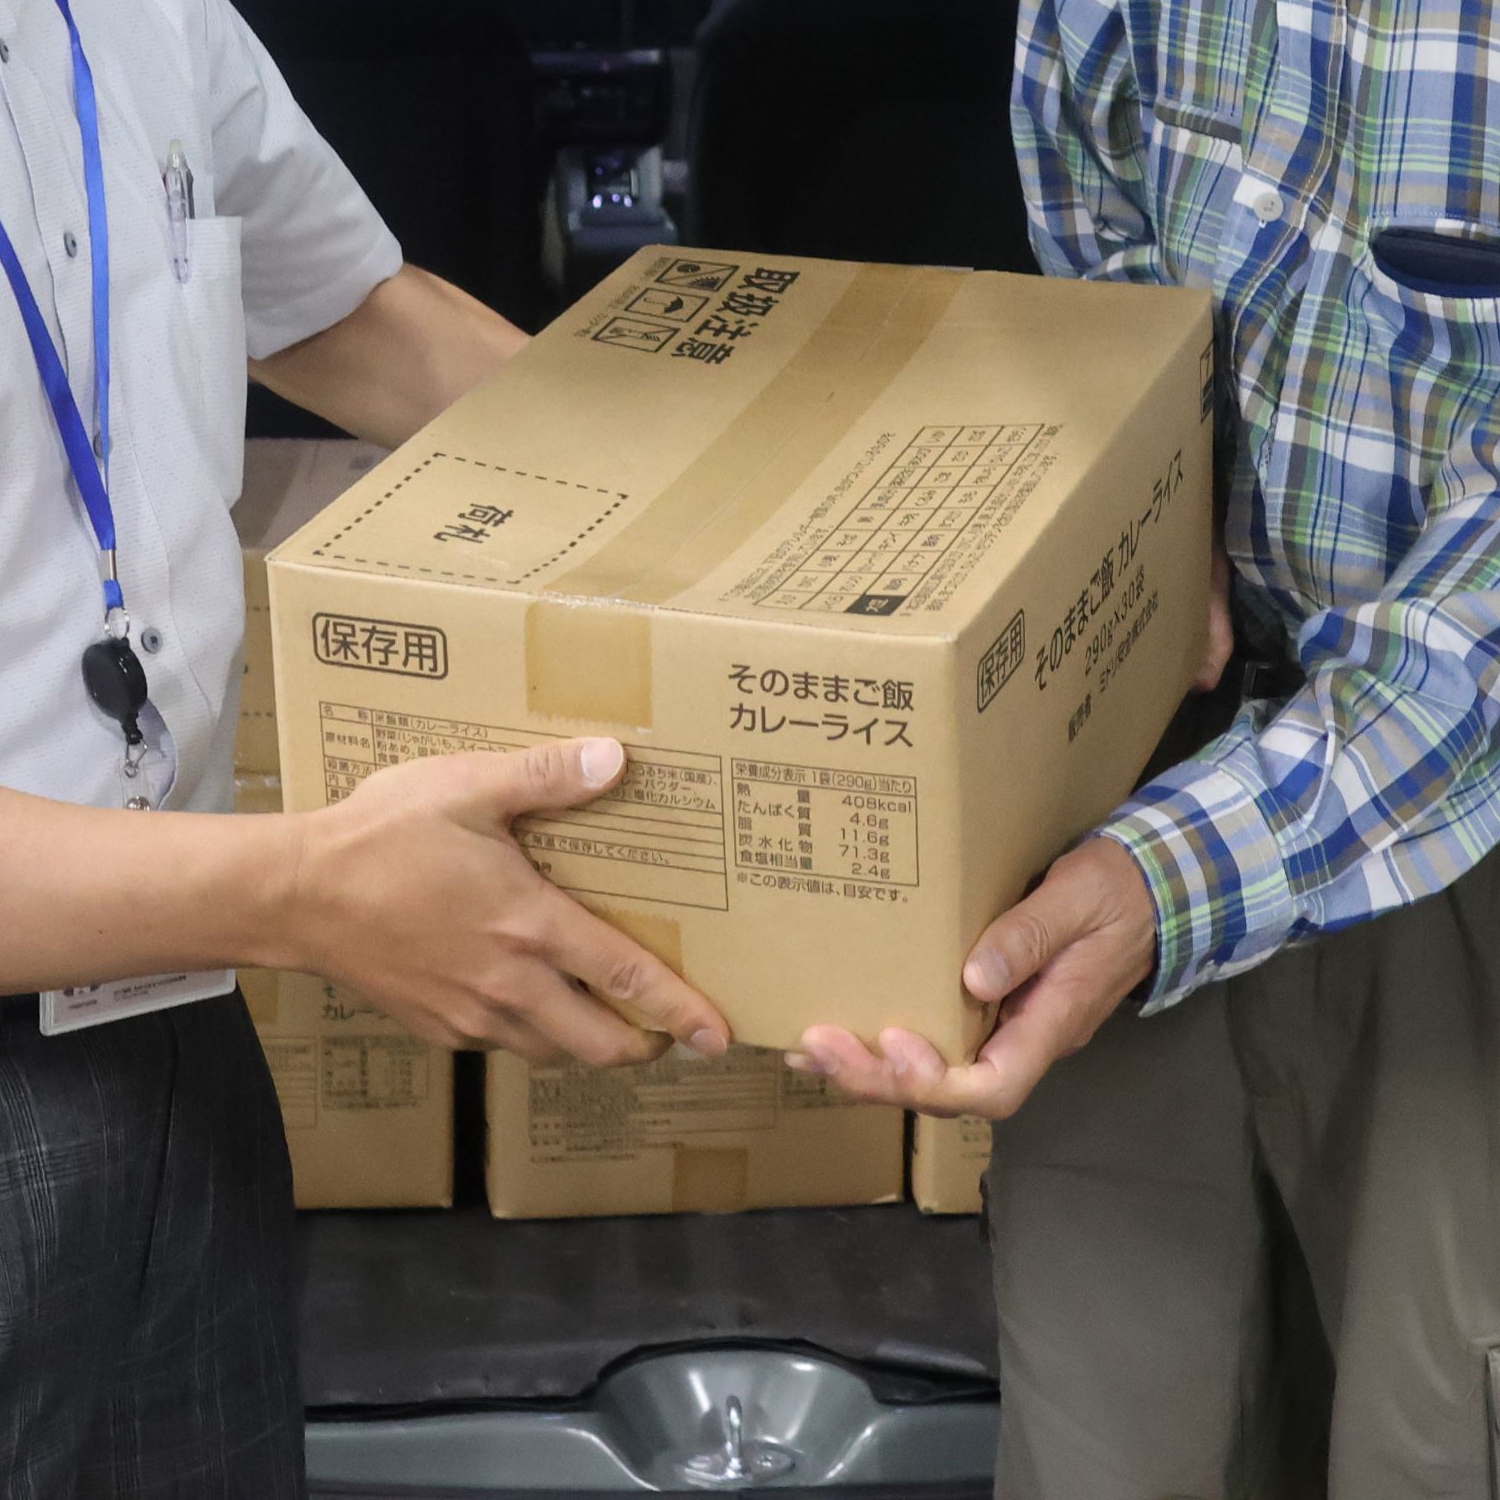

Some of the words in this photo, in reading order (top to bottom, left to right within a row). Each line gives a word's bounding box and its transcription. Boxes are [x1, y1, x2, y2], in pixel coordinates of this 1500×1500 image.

[672, 268, 800, 364] 取扱注意
[433, 503, 514, 544] 荷札
[1035, 548, 1114, 690] そのままご飯
[1119, 450, 1182, 577] カレーライス
[320, 619, 438, 672] 保存用
[980, 617, 1023, 703] 保存用
[728, 664, 914, 711] そのままご飯
[730, 703, 913, 747] カレーライス
[737, 799, 811, 821] たんぱく質
[850, 813, 889, 830] 4.6g
[841, 794, 912, 814] 408kcal
[838, 844, 890, 863] 71.3g
[840, 828, 890, 847] 11.6g
[740, 850, 813, 870] 食塩相当量
[851, 863, 891, 880] 2.4g
